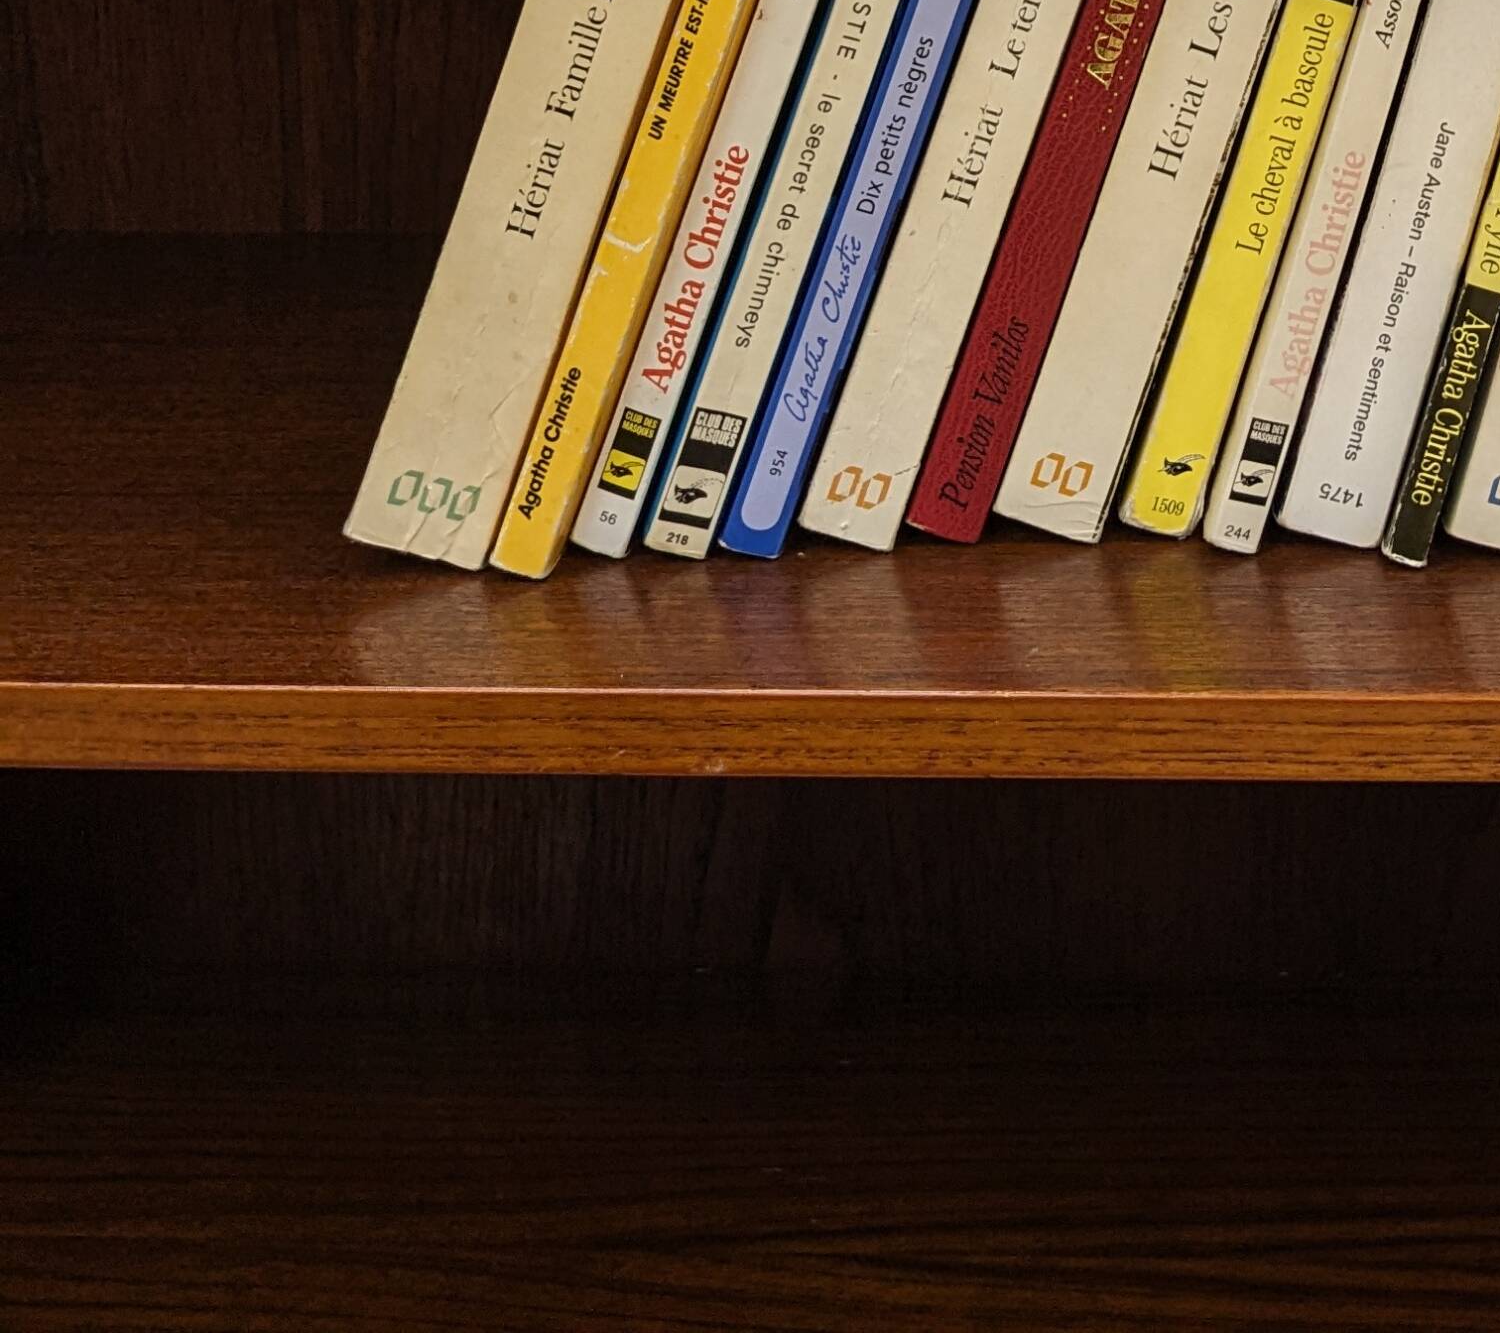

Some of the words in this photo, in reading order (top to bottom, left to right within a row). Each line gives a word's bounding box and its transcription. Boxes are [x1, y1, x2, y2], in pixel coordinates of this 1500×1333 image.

[1282, 12, 1335, 109] bascule
[648, 115, 667, 141] UN
[658, 38, 694, 113] MEURTRE
[817, 92, 842, 114] le
[1147, 74, 1209, 181] Hériat
[1188, 1, 1233, 61] Les
[505, 138, 565, 240] Hériat
[544, 5, 607, 121] Famille
[856, 180, 884, 215] Dix
[875, 113, 907, 176] petits
[898, 36, 934, 108] nègres
[942, 103, 1003, 209] Hériat
[988, 39, 1026, 80] Le
[1274, 113, 1303, 131] à
[1431, 122, 1455, 170] Jane
[788, 123, 825, 194] secret
[1251, 134, 1296, 216] cheval
[776, 203, 800, 231] de
[1409, 173, 1441, 241] Austen
[1235, 222, 1268, 255] Le
[641, 280, 706, 394] Agatha
[684, 144, 750, 271] Christie
[735, 241, 786, 349] chimneys
[1270, 286, 1328, 397] Agatha
[1305, 149, 1366, 276] Christie
[1383, 261, 1416, 328] Raison
[1376, 331, 1392, 353] et
[1441, 309, 1491, 399] Agatha
[621, 420, 654, 439] MASQUES
[625, 410, 643, 425] CLUB
[643, 417, 658, 429] DES
[691, 425, 738, 448] MASQUES
[695, 410, 720, 431] CLUB
[721, 415, 742, 434] DES
[938, 414, 995, 513] Pension
[972, 316, 1030, 407] Vanilos
[1251, 420, 1271, 432] CLUB
[1344, 356, 1385, 461] sentiments
[517, 443, 556, 521] Agatha
[543, 366, 582, 443] Christie
[769, 448, 788, 477] 954
[1251, 430, 1284, 446] MASQUES
[1410, 406, 1463, 507] Christie
[599, 509, 618, 526] 56
[1151, 496, 1186, 517] 1509
[1319, 483, 1364, 509] 1475
[665, 531, 689, 546] 218
[1224, 525, 1250, 541] 244
